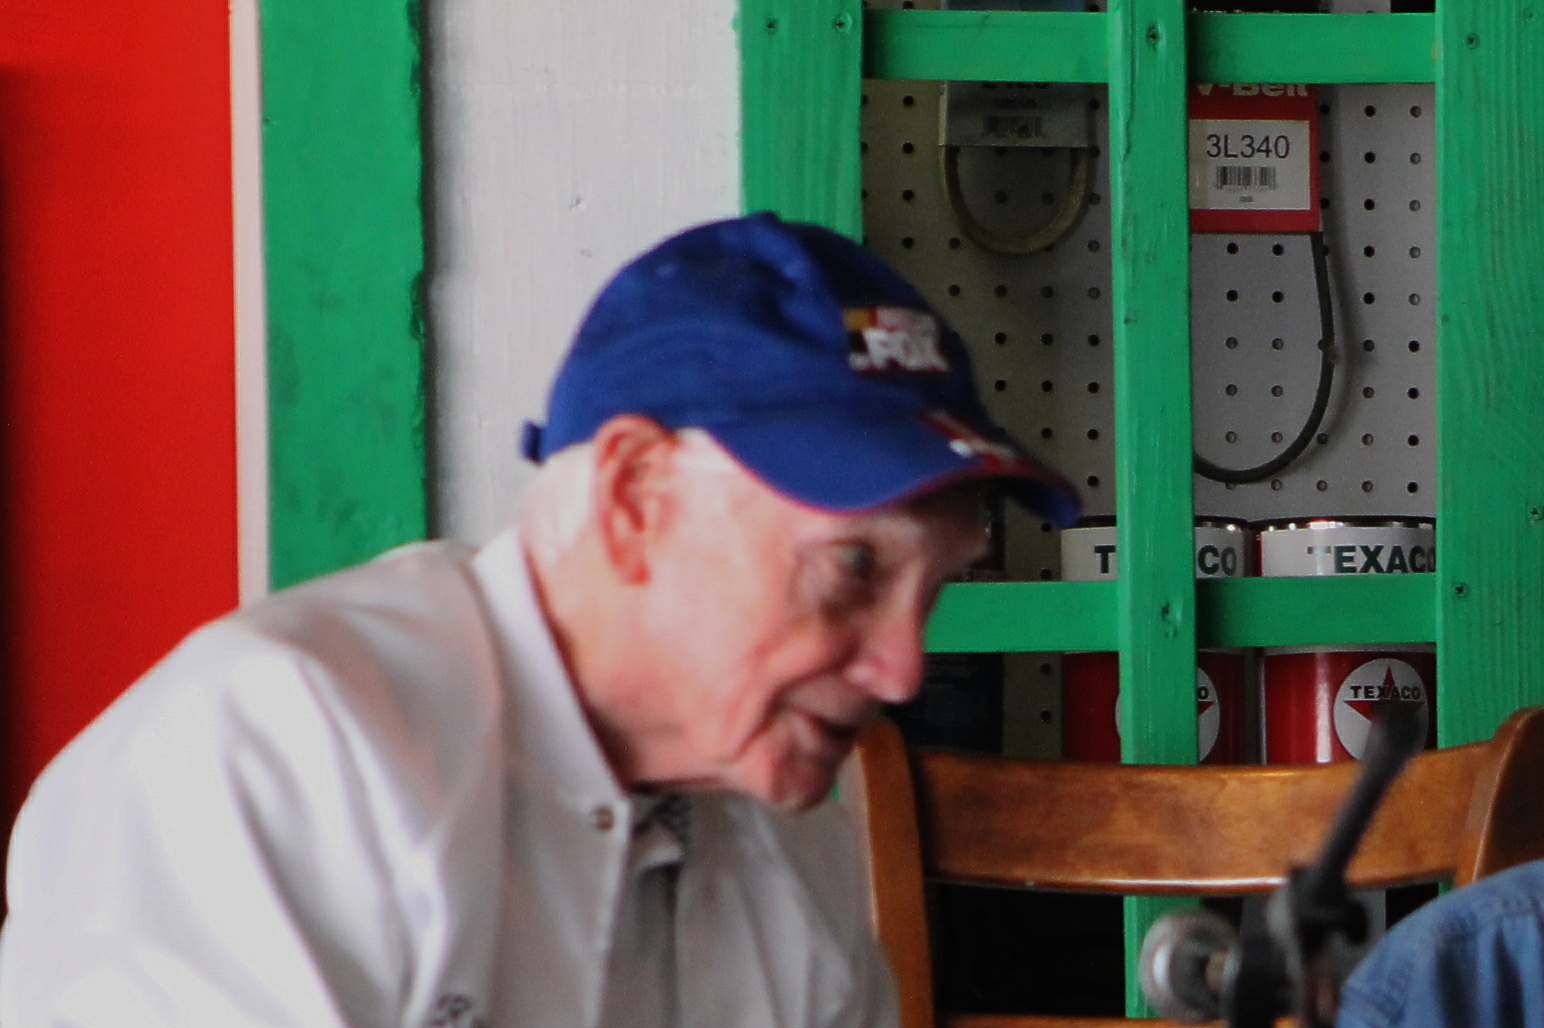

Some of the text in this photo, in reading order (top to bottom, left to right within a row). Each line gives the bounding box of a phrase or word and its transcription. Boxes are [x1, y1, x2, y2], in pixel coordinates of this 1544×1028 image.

[1205, 133, 1290, 159] 3L340
[1307, 544, 1436, 574] TEXACO
[1350, 685, 1421, 701] TEXACO
